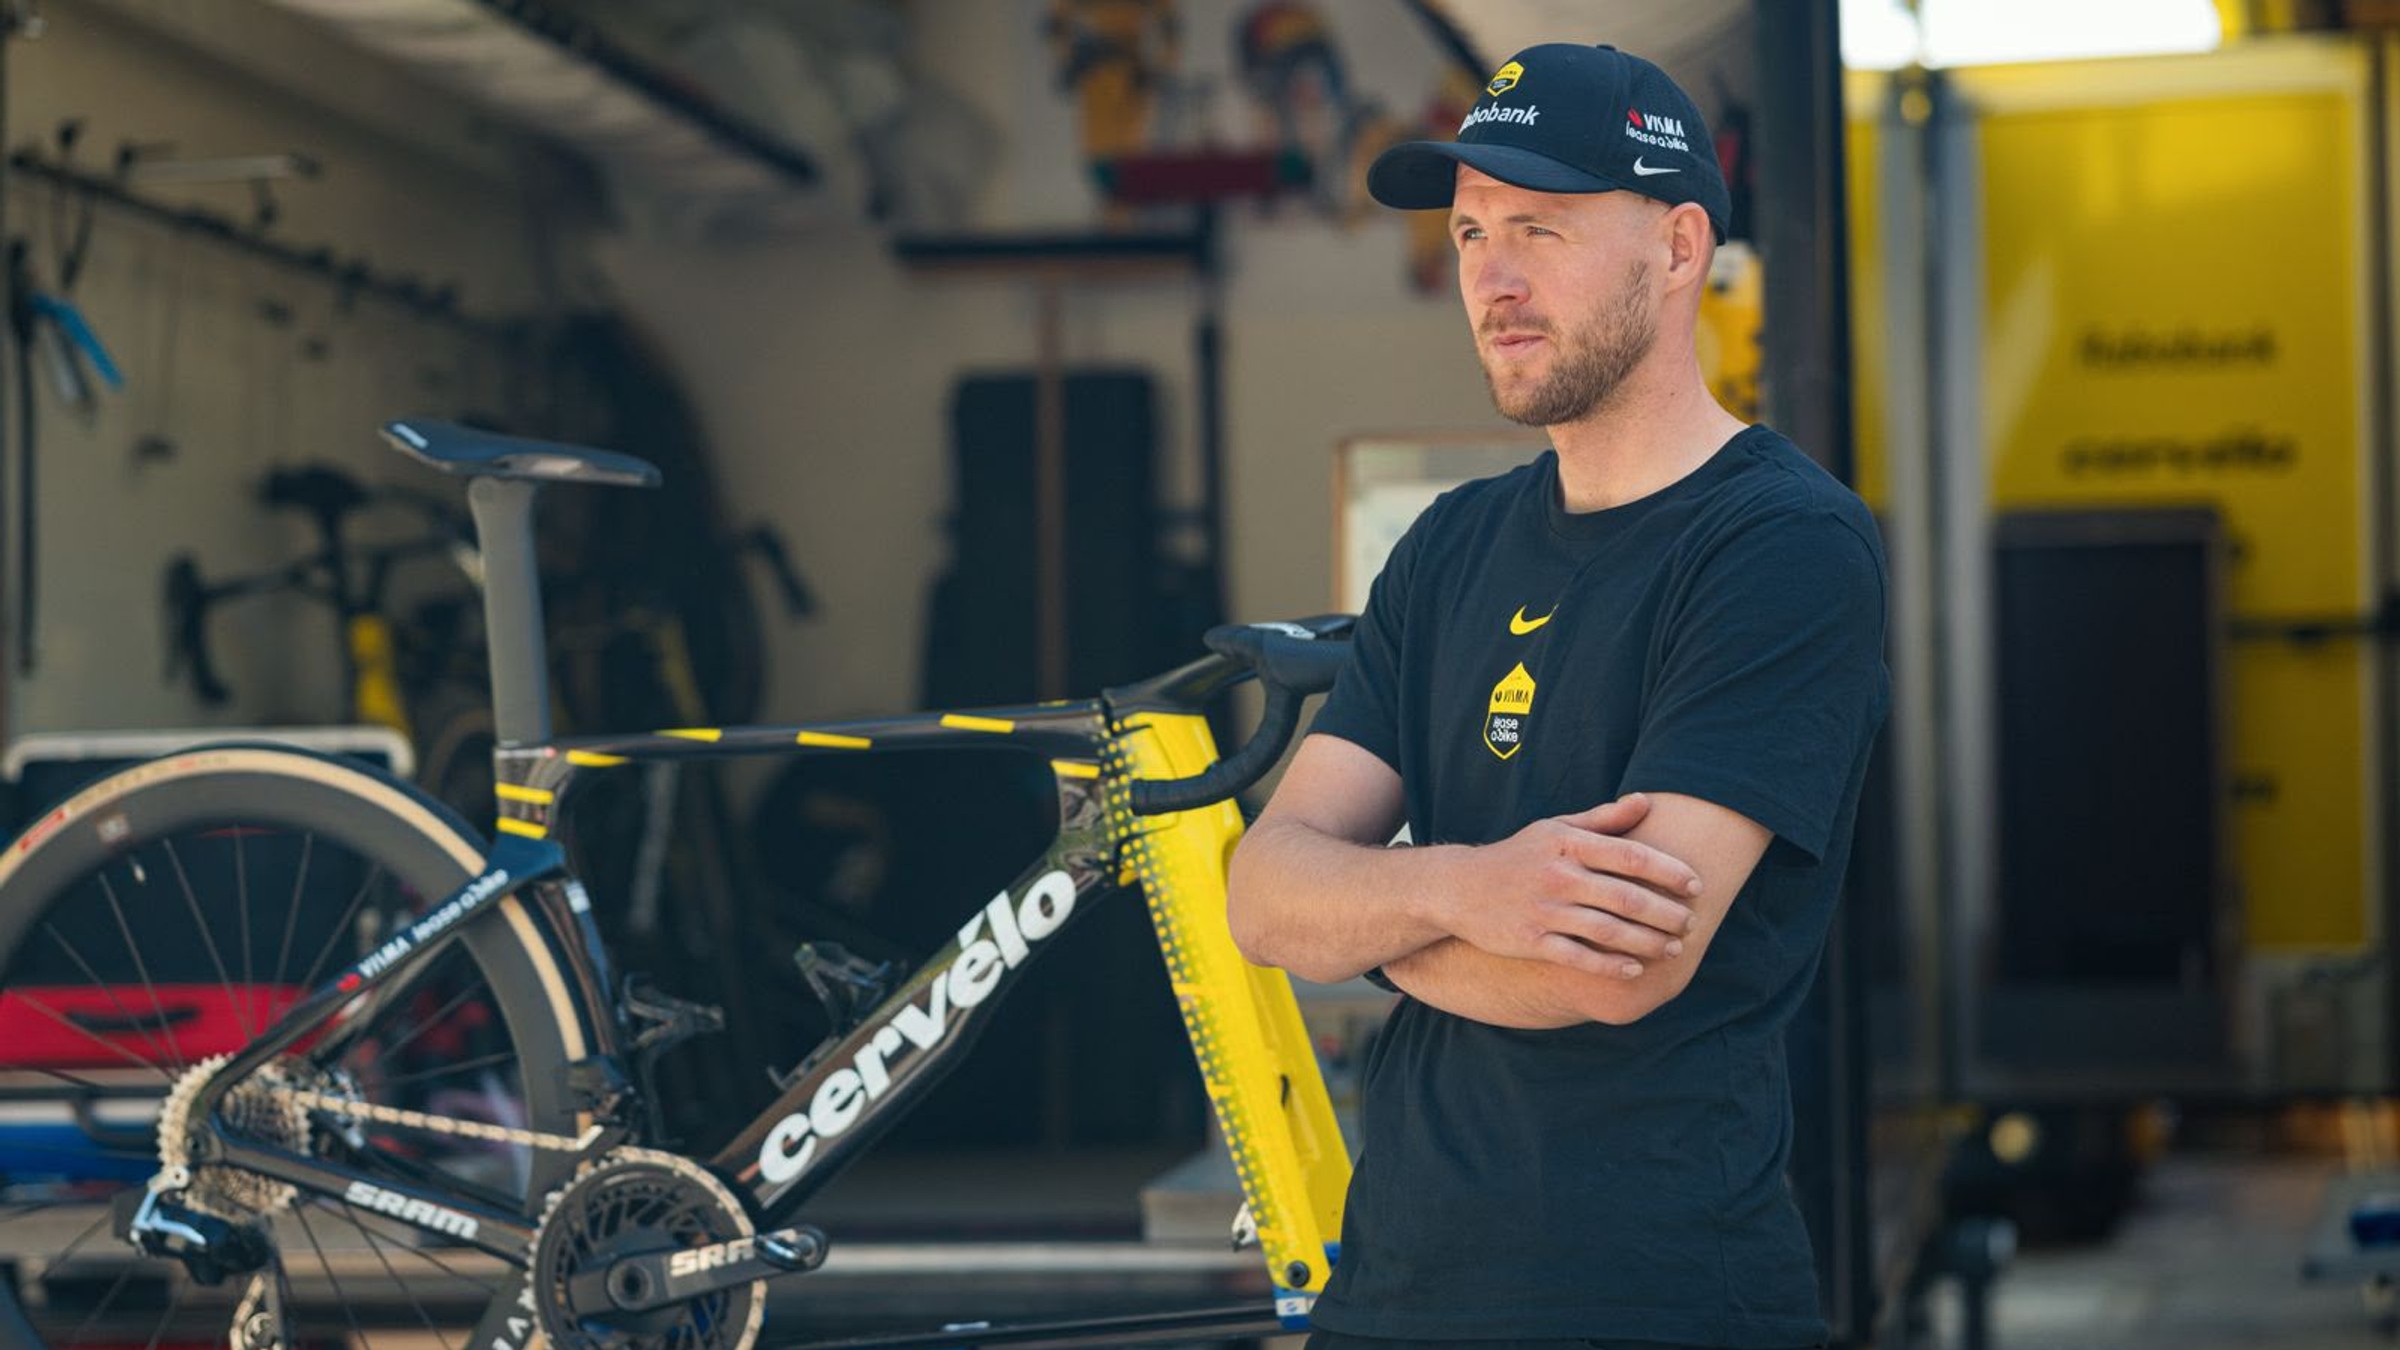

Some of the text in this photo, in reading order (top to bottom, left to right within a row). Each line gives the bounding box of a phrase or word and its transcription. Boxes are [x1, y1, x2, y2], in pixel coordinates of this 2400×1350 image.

[1458, 101, 1540, 135] bobank
[1644, 114, 1685, 137] VISMA
[759, 870, 1076, 1183] cervélo
[345, 1180, 479, 1240] SRAM
